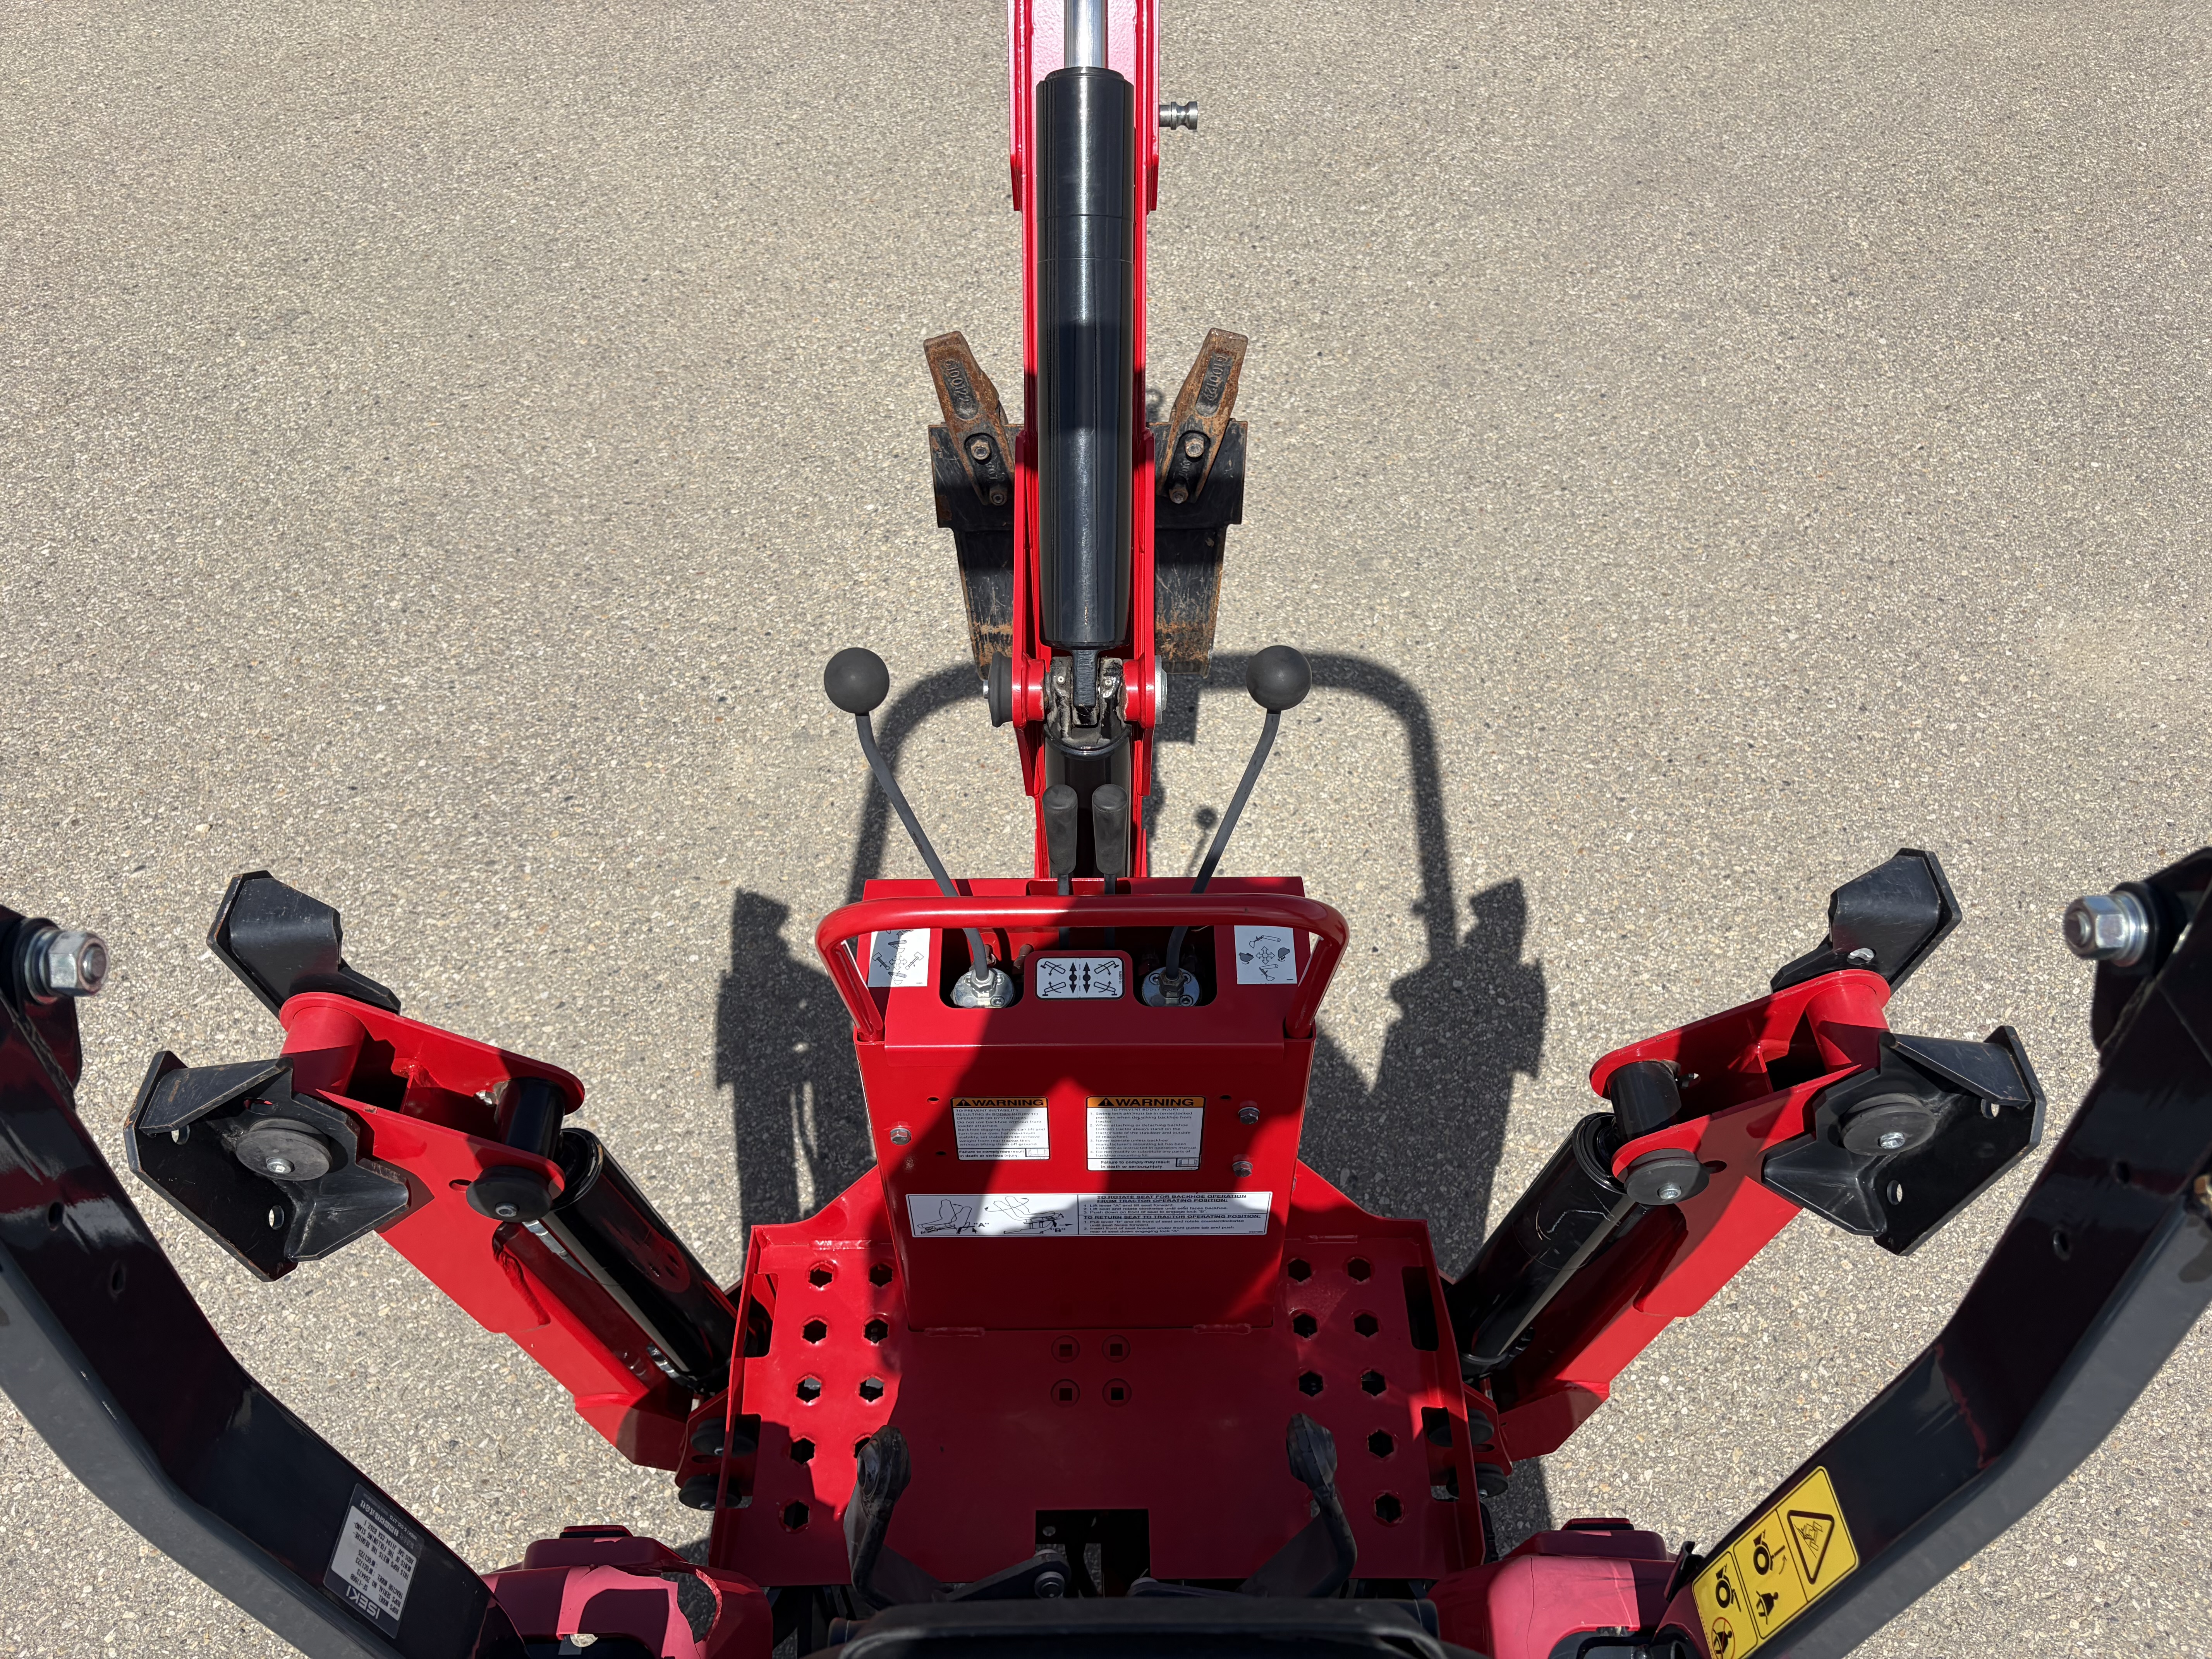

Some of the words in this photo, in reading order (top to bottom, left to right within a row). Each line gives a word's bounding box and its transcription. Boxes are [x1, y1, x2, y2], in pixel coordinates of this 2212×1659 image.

[367, 1532, 386, 1552] FOLLOWING
[378, 1551, 390, 1564] MEETS
[390, 1561, 400, 1572] ROPS
[400, 1559, 411, 1572] MENTS
[376, 1573, 388, 1586] MODEL
[400, 1569, 409, 1580] THIS
[378, 1584, 391, 1599] SERIAL
[388, 1583, 403, 1599] TRACTOR
[345, 1584, 380, 1620] ISEKI
[377, 1594, 389, 1607] MODEL
[392, 1595, 401, 1607] ROPS
[389, 1603, 398, 1615] ROPS
